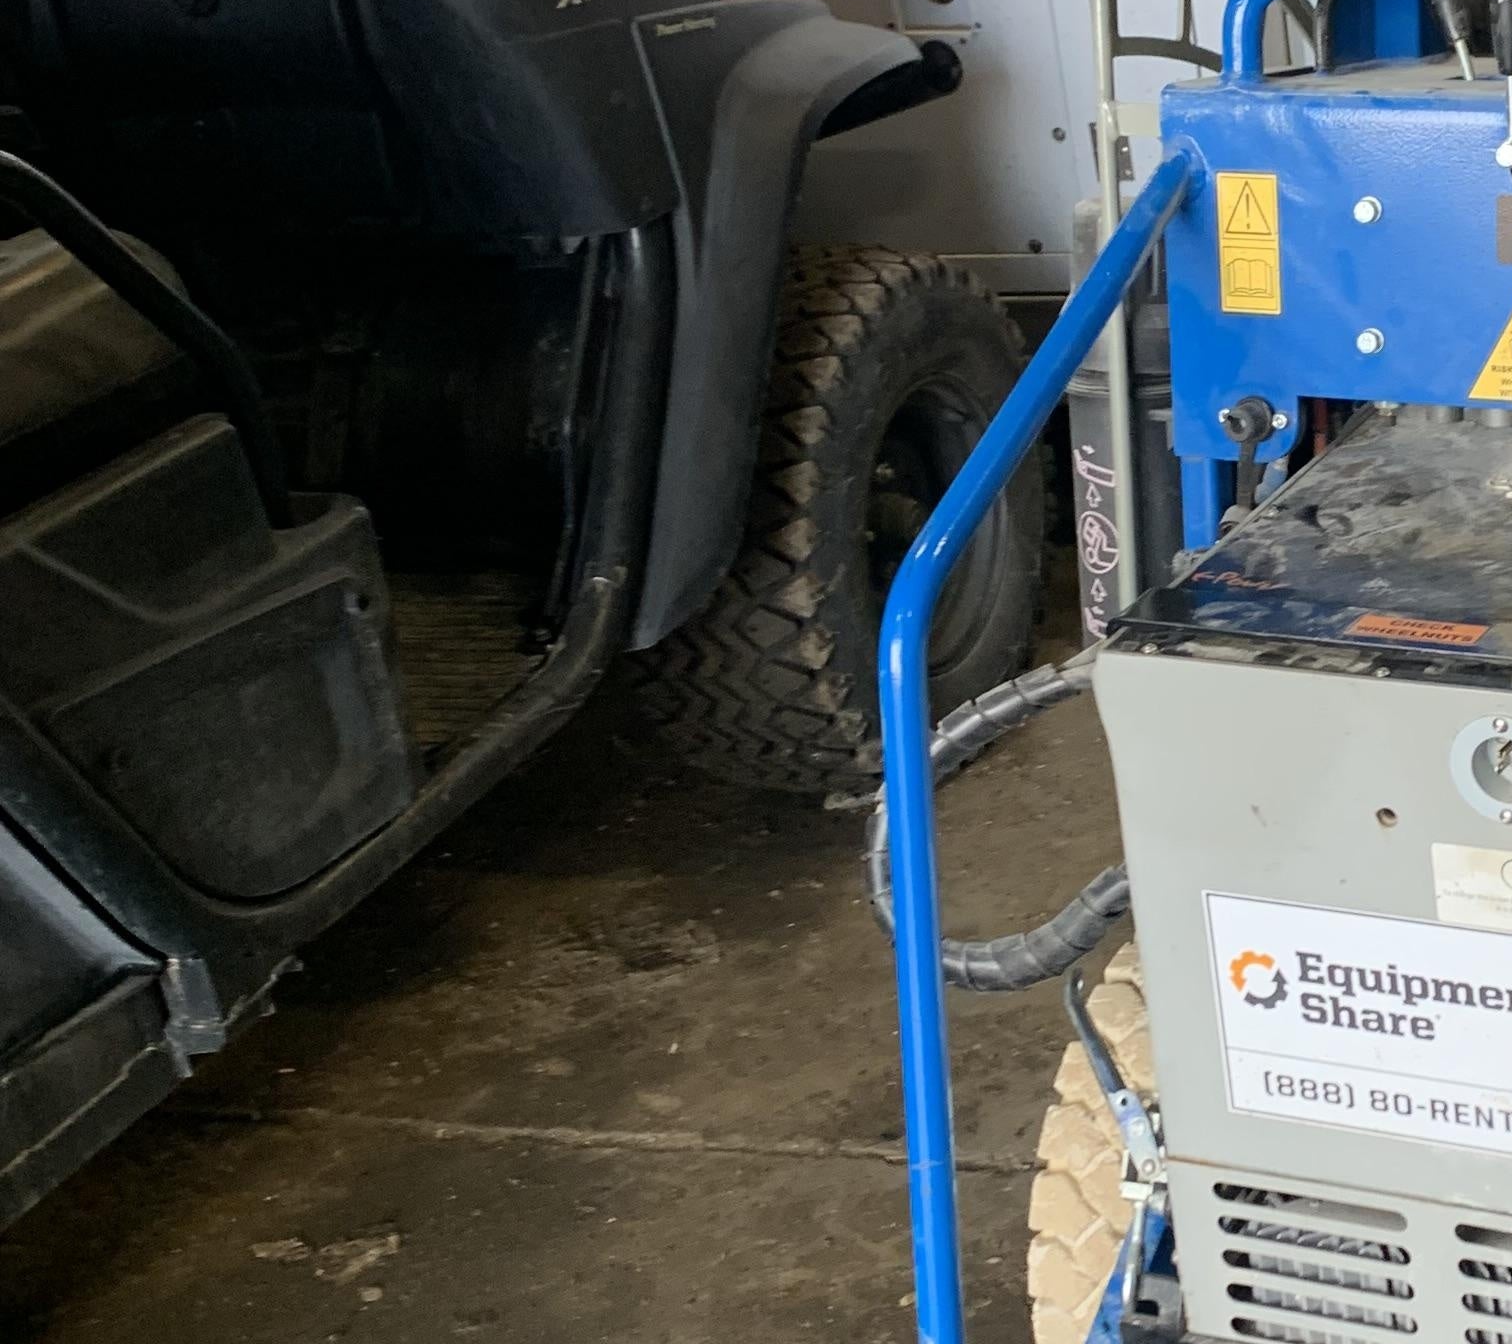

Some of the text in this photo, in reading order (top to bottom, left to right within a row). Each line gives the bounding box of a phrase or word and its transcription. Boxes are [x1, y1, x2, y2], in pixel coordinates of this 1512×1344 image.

[1491, 364, 1512, 374] RISK
[1356, 625, 1473, 643] WHEELNUTS
[1389, 619, 1457, 631] CHECK
[1299, 992, 1436, 1042] Share
[1263, 1070, 1357, 1109] (888)
